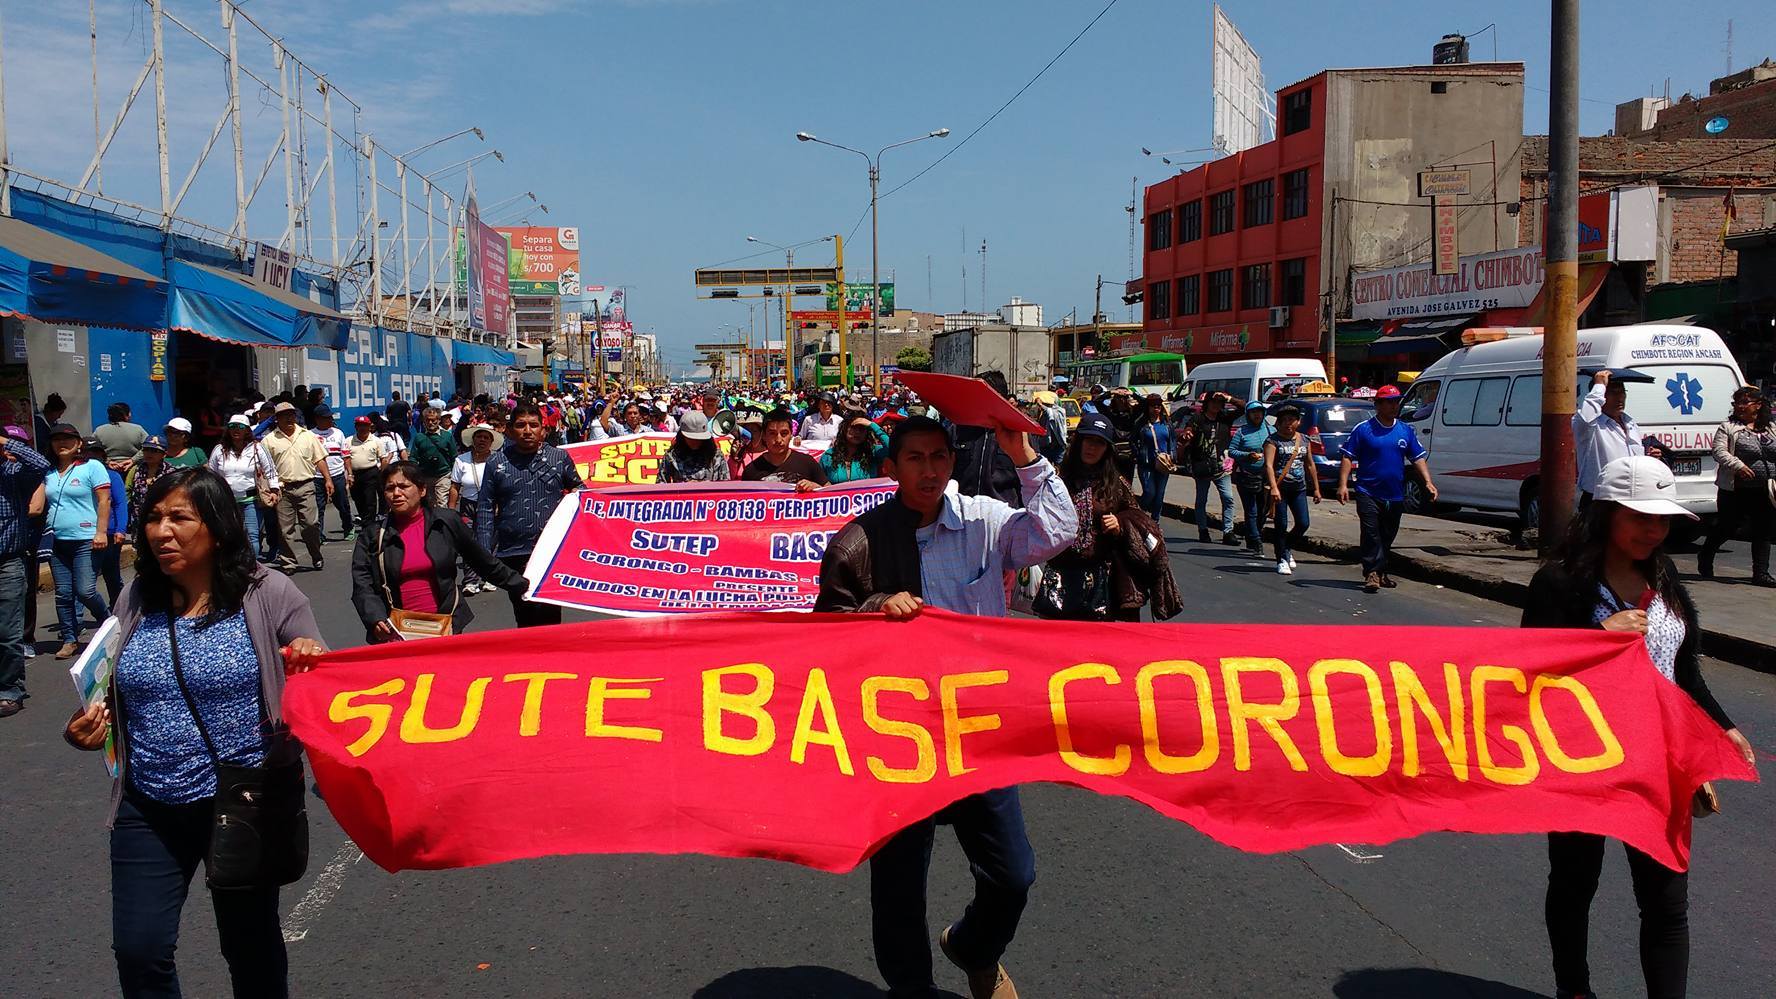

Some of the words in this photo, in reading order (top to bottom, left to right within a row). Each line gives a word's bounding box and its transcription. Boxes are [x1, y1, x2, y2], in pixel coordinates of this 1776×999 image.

[523, 235, 553, 244] Separa
[523, 244, 533, 252] tu
[524, 253, 538, 262] hoy
[1355, 273, 1393, 305] CENTRO
[1396, 263, 1470, 299] COMERCIAL
[1387, 304, 1420, 317] AVENIDA
[1422, 302, 1443, 313] JOSE
[1444, 299, 1481, 312] GALVEZ
[1483, 298, 1499, 309] 525
[1161, 334, 1185, 347] Mifarma
[1211, 329, 1239, 346] Mifarma
[344, 328, 399, 368] CAJA
[1631, 349, 1669, 359] CHIMBOTE
[1669, 349, 1695, 359] REGION
[1695, 350, 1722, 359] ANCASH
[152, 340, 166, 375] COPIAS
[345, 371, 386, 408] DEL
[1312, 382, 1323, 393] 19
[608, 500, 693, 523] INTEGRADA
[716, 500, 766, 520] 88138
[630, 529, 719, 556] SUTEP
[579, 549, 688, 575] CORONGO
[705, 565, 798, 583] BAMBAS
[639, 586, 665, 600] EN
[668, 590, 693, 602] LA
[696, 590, 758, 603] LUCHA
[713, 580, 799, 593] PRESENTE
[327, 672, 664, 758] SUTE
[701, 662, 1010, 784] BASE
[1047, 656, 1626, 786] CORONGO
